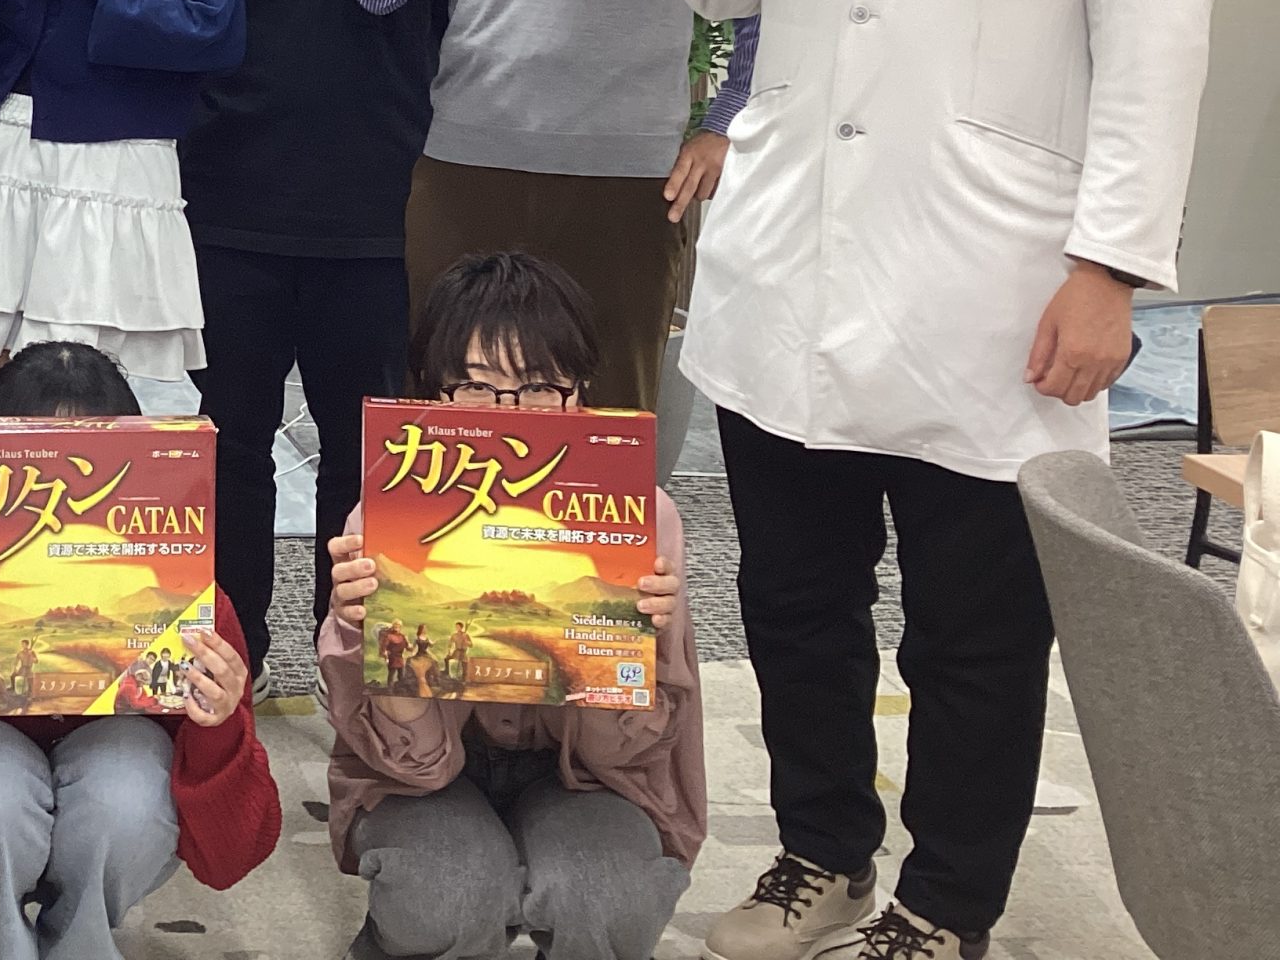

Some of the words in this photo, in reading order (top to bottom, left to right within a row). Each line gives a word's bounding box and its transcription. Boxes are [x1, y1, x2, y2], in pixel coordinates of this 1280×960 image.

[427, 426, 456, 437] Klaus
[458, 427, 493, 438] Teuber
[24, 449, 58, 459] Teuber
[382, 424, 567, 544] カタン
[543, 490, 646, 525] CATAN
[106, 505, 206, 536] CATAN
[483, 526, 648, 546] 資源で未来を開拓するロマン
[48, 543, 206, 557] 資源で未来を開拓するロマン
[572, 614, 614, 627] Siedeln
[134, 623, 167, 635] Siedel
[565, 629, 614, 642] Handeln
[579, 644, 614, 656] Bauen
